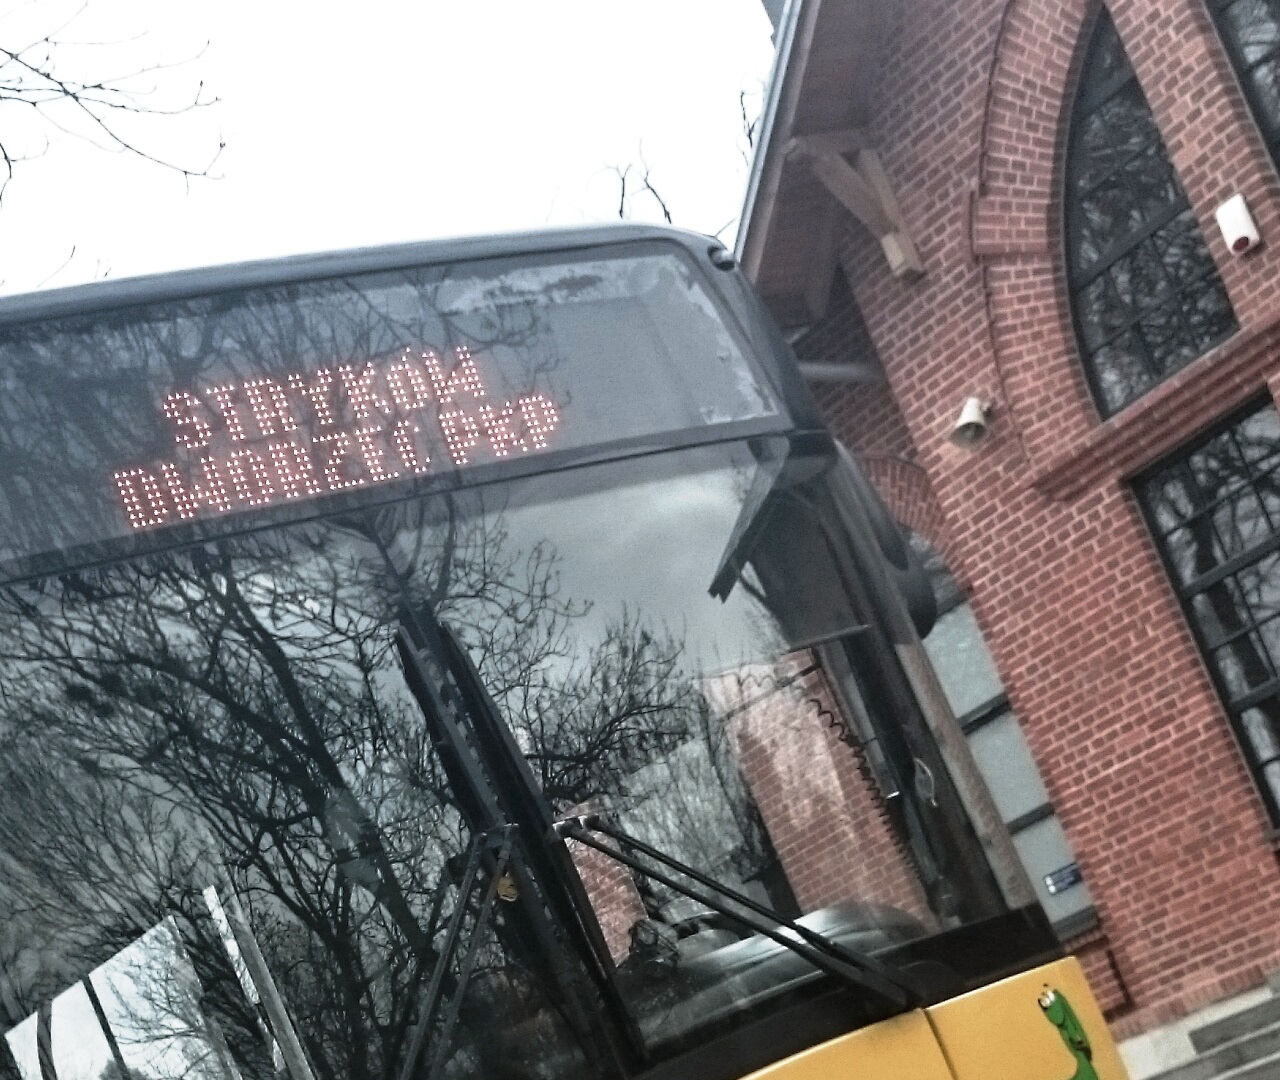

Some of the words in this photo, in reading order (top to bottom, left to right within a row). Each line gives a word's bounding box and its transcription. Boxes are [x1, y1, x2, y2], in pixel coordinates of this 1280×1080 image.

[163, 345, 483, 450] STRYKÓW
[113, 416, 431, 529] DWORZEC
[438, 394, 560, 466] PKP
